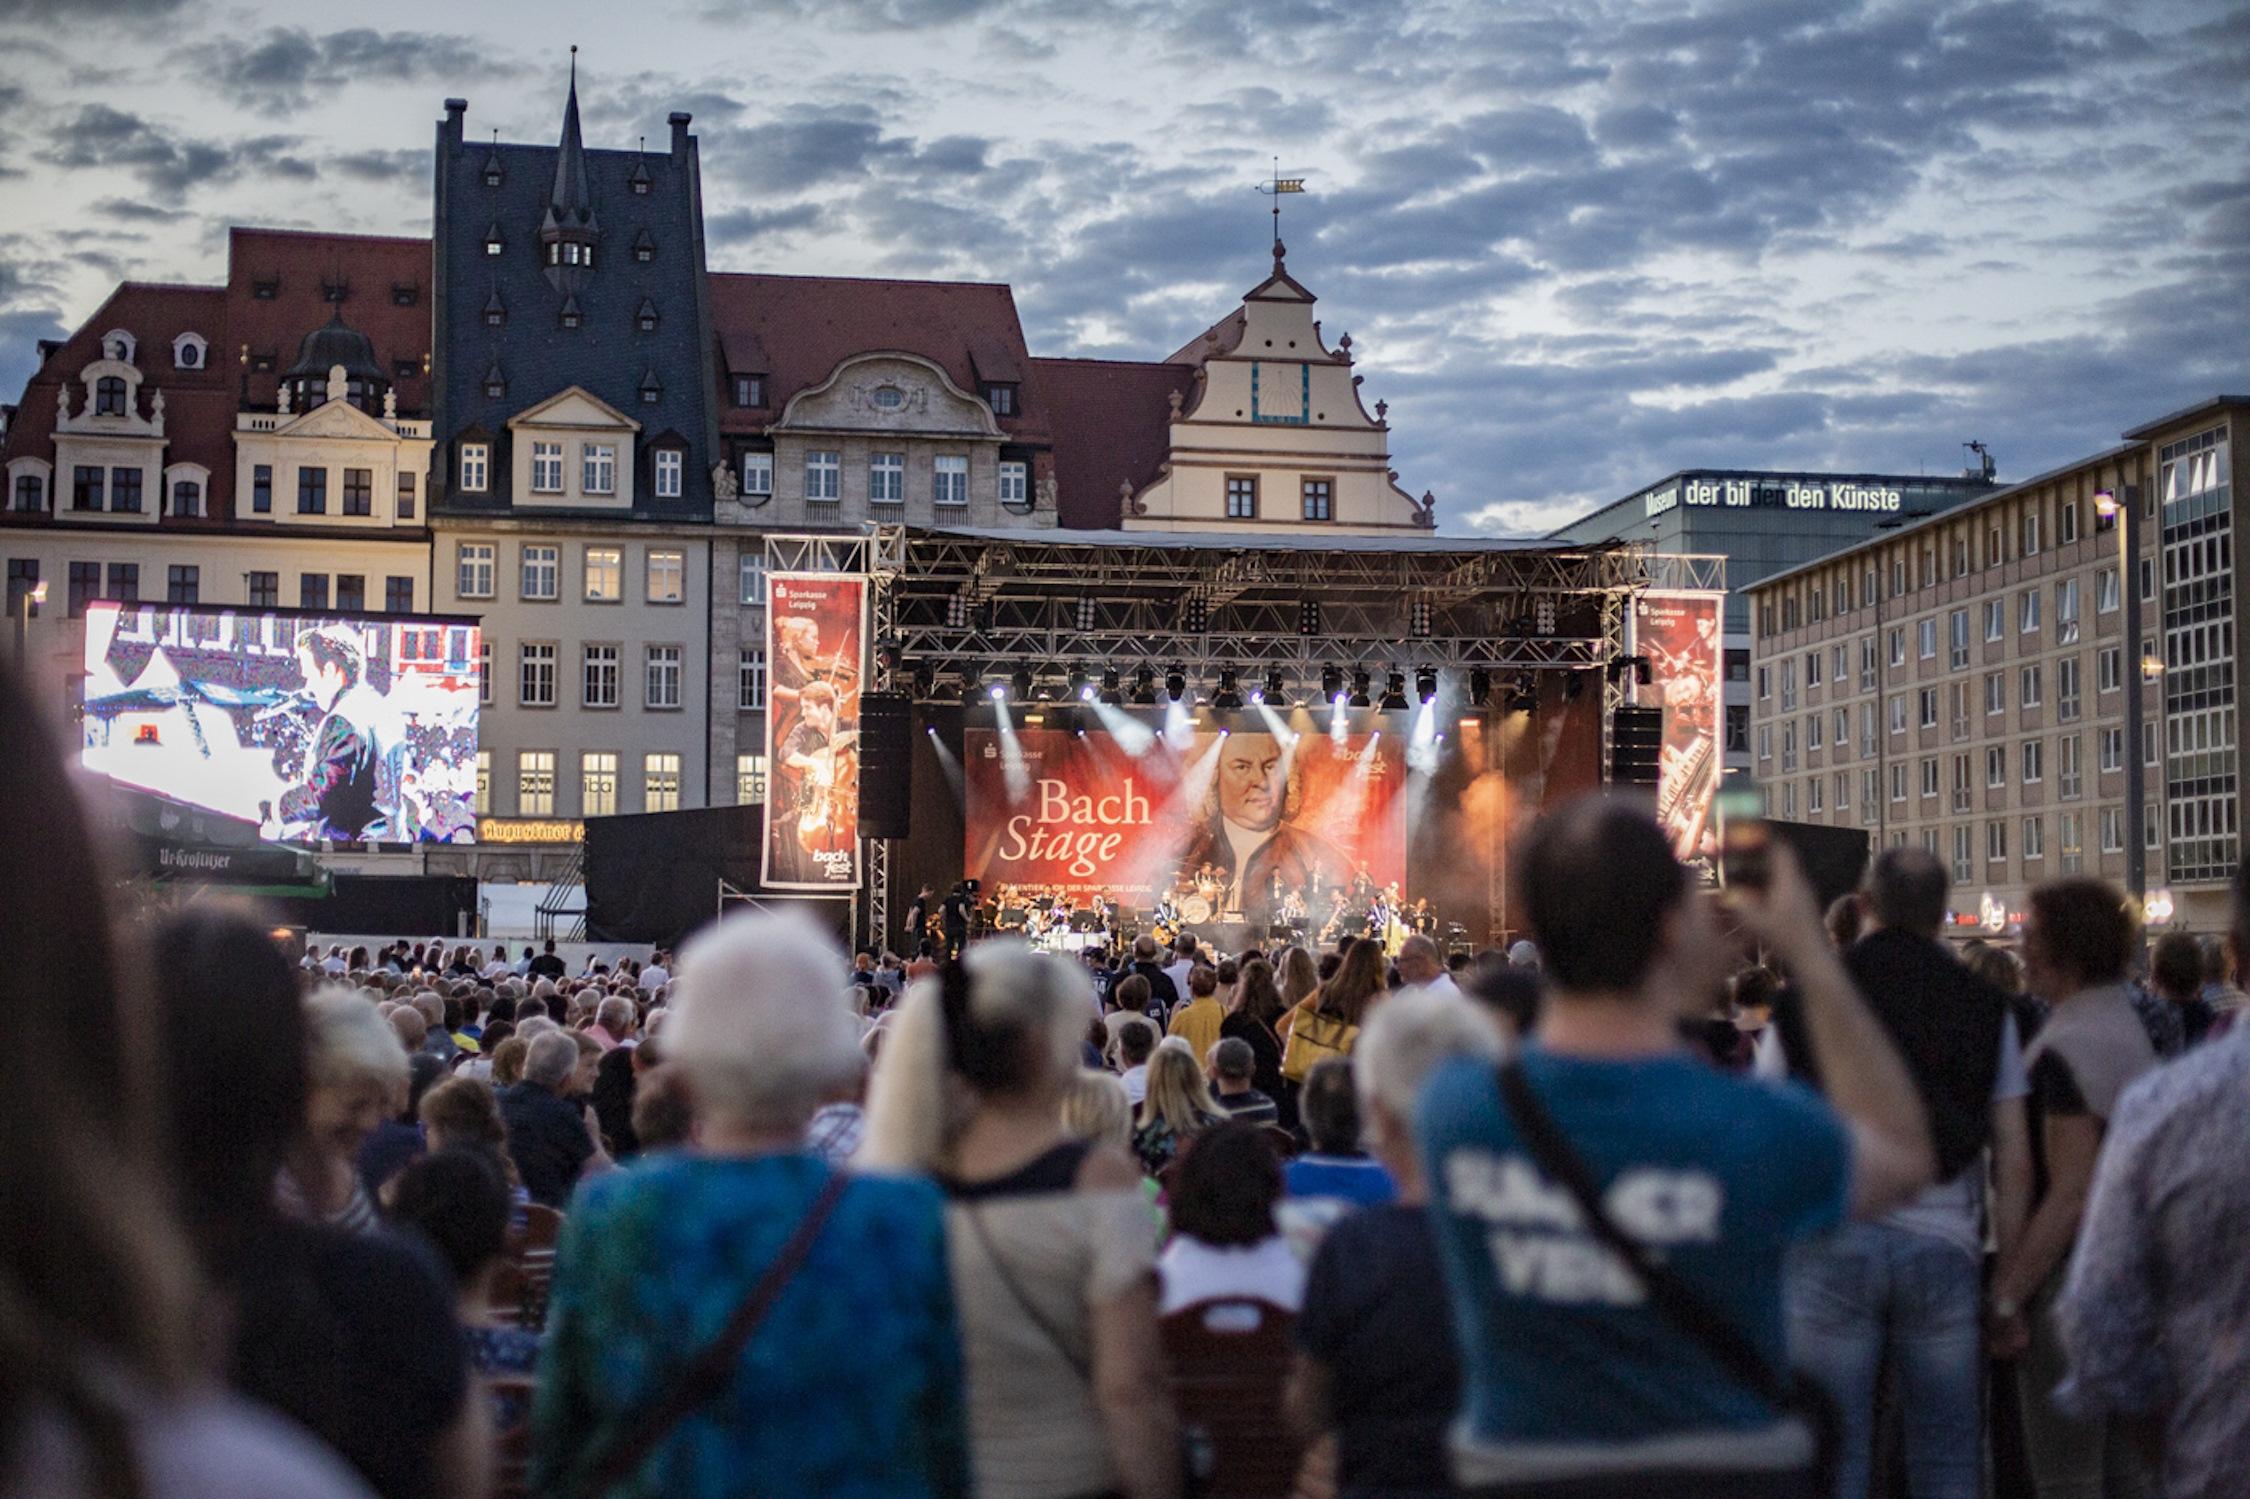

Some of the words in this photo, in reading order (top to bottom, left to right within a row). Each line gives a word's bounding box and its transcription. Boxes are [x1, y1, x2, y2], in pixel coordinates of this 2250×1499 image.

[1646, 487, 1678, 518] Museum
[1685, 479, 1720, 506] der
[1831, 484, 1900, 511] Künste
[788, 590, 827, 600] Sparkasse
[788, 601, 817, 611] Leipzig
[1650, 607, 1685, 617] Sparkasse
[1650, 618, 1676, 628] Leipzig
[584, 777, 612, 793] iba
[1037, 777, 1152, 825] Bach
[482, 819, 571, 843] Augustiner
[999, 815, 1122, 877] Stage
[813, 848, 849, 862] bach
[824, 861, 852, 878] fest
[1067, 884, 1081, 893] DER
